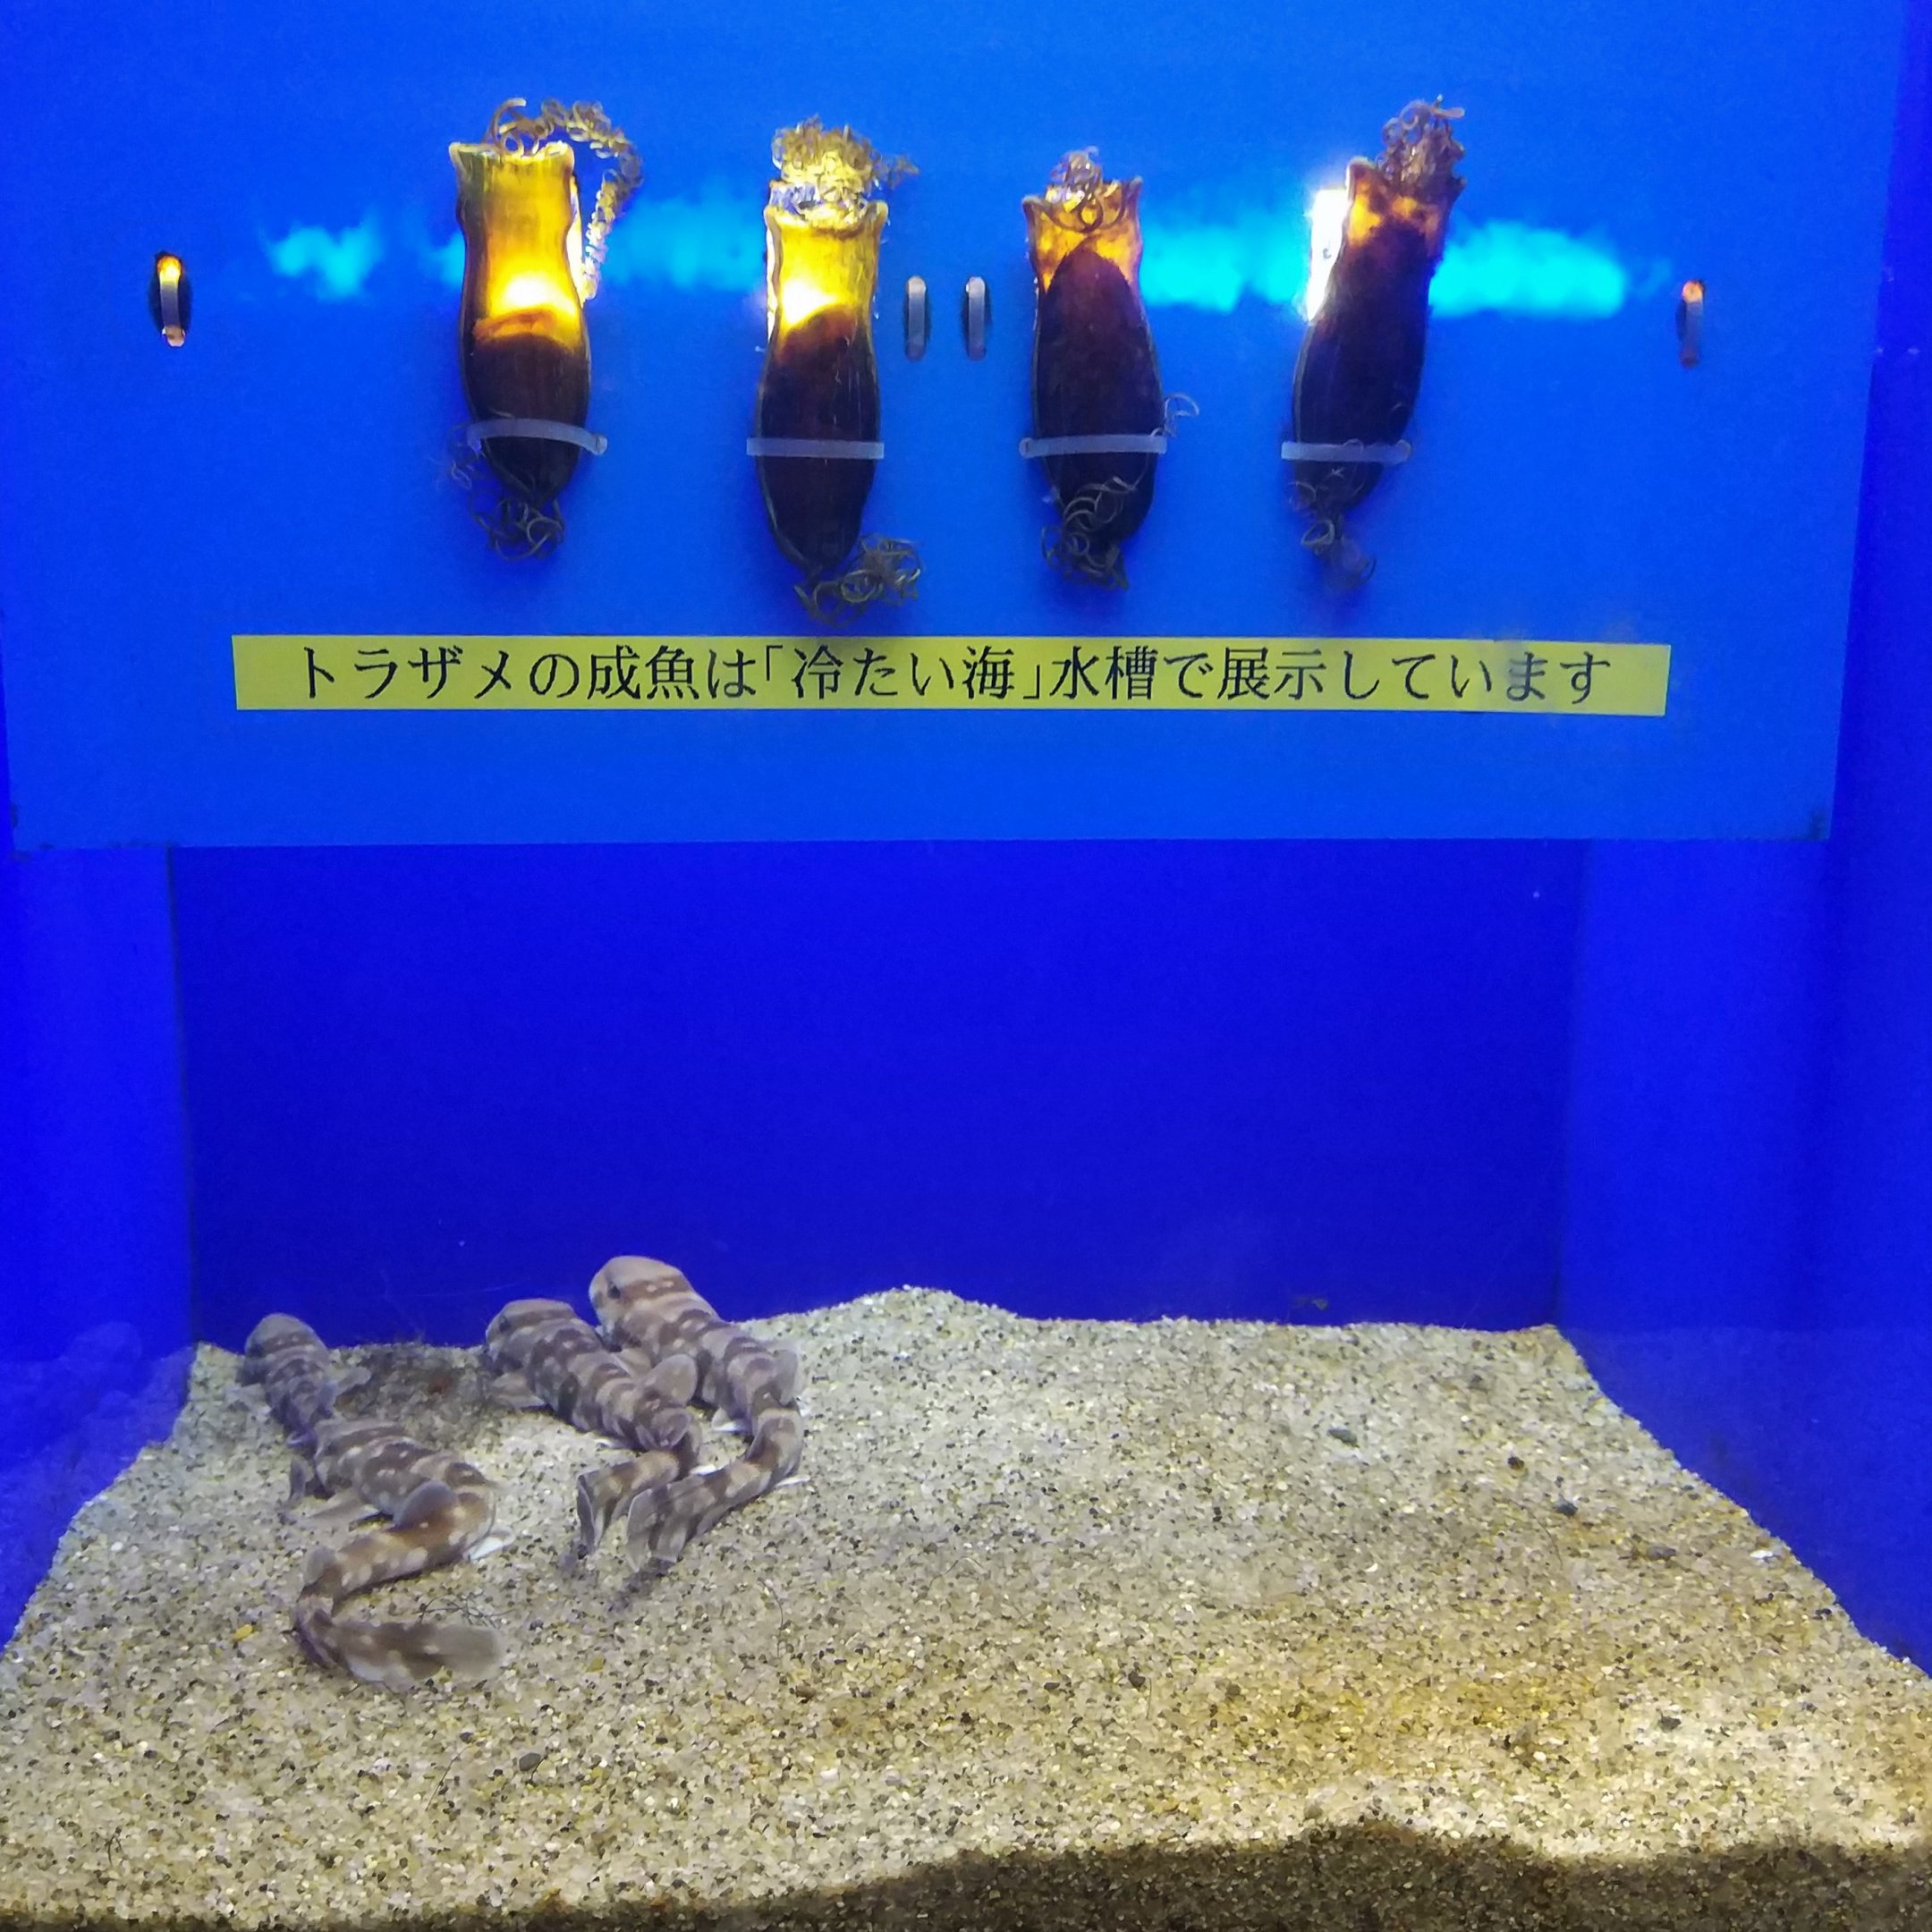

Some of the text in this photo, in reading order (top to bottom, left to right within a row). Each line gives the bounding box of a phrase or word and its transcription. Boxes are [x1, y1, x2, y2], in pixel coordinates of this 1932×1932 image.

[303, 644, 1612, 704] トラザメの成魚は「冷たい海」水槽で展示しています
